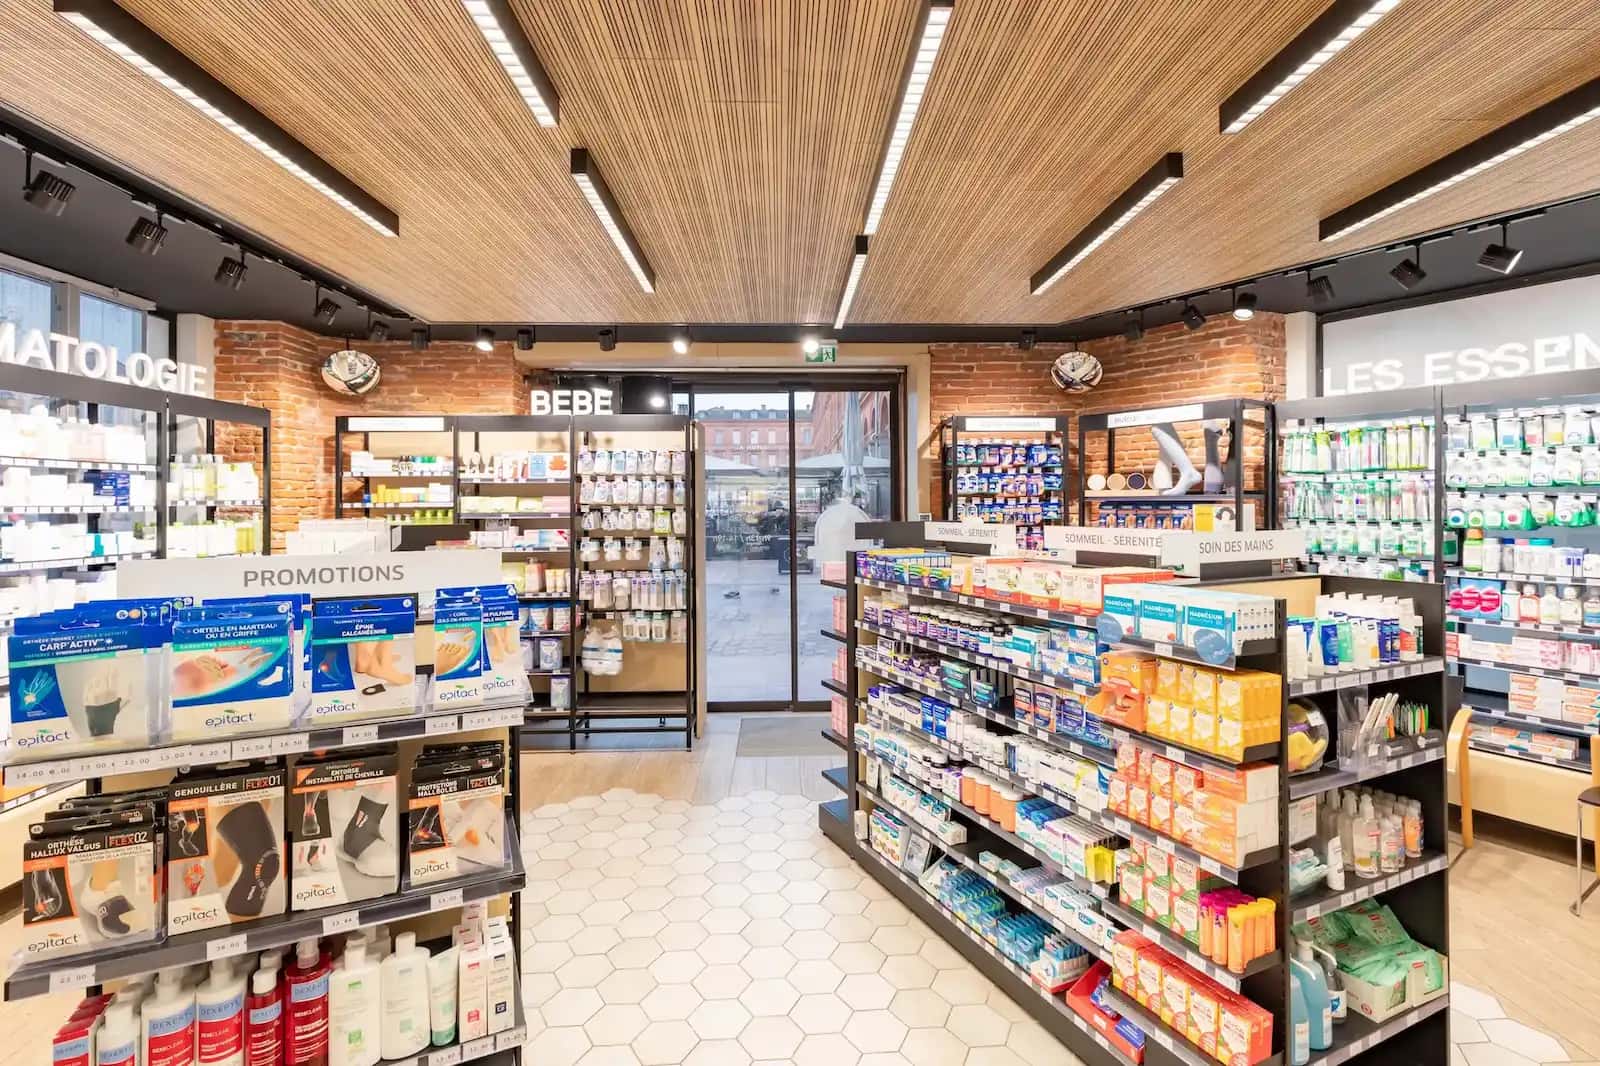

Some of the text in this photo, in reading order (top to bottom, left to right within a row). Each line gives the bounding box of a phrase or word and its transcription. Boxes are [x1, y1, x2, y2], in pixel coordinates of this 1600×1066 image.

[1323, 359, 1405, 395] LES
[1064, 533, 1105, 545] SOMMEIL
[1199, 539, 1274, 554] SOIN DES MAINS
[243, 565, 405, 587] PROMOTIONS
[192, 626, 225, 635] ORTEILS
[439, 687, 480, 701] epitact
[316, 701, 357, 715] epitact
[204, 712, 254, 727] epitact
[17, 730, 71, 748] epitact
[354, 770, 384, 779] CHEVILLE
[174, 782, 238, 797] GENOUILLÈRE
[30, 848, 66, 859] HALLUX
[66, 842, 101, 854] VALGUS
[413, 861, 449, 877] epitact
[296, 884, 337, 901] epitact
[172, 907, 218, 925] epitact
[28, 934, 79, 953] epitact
